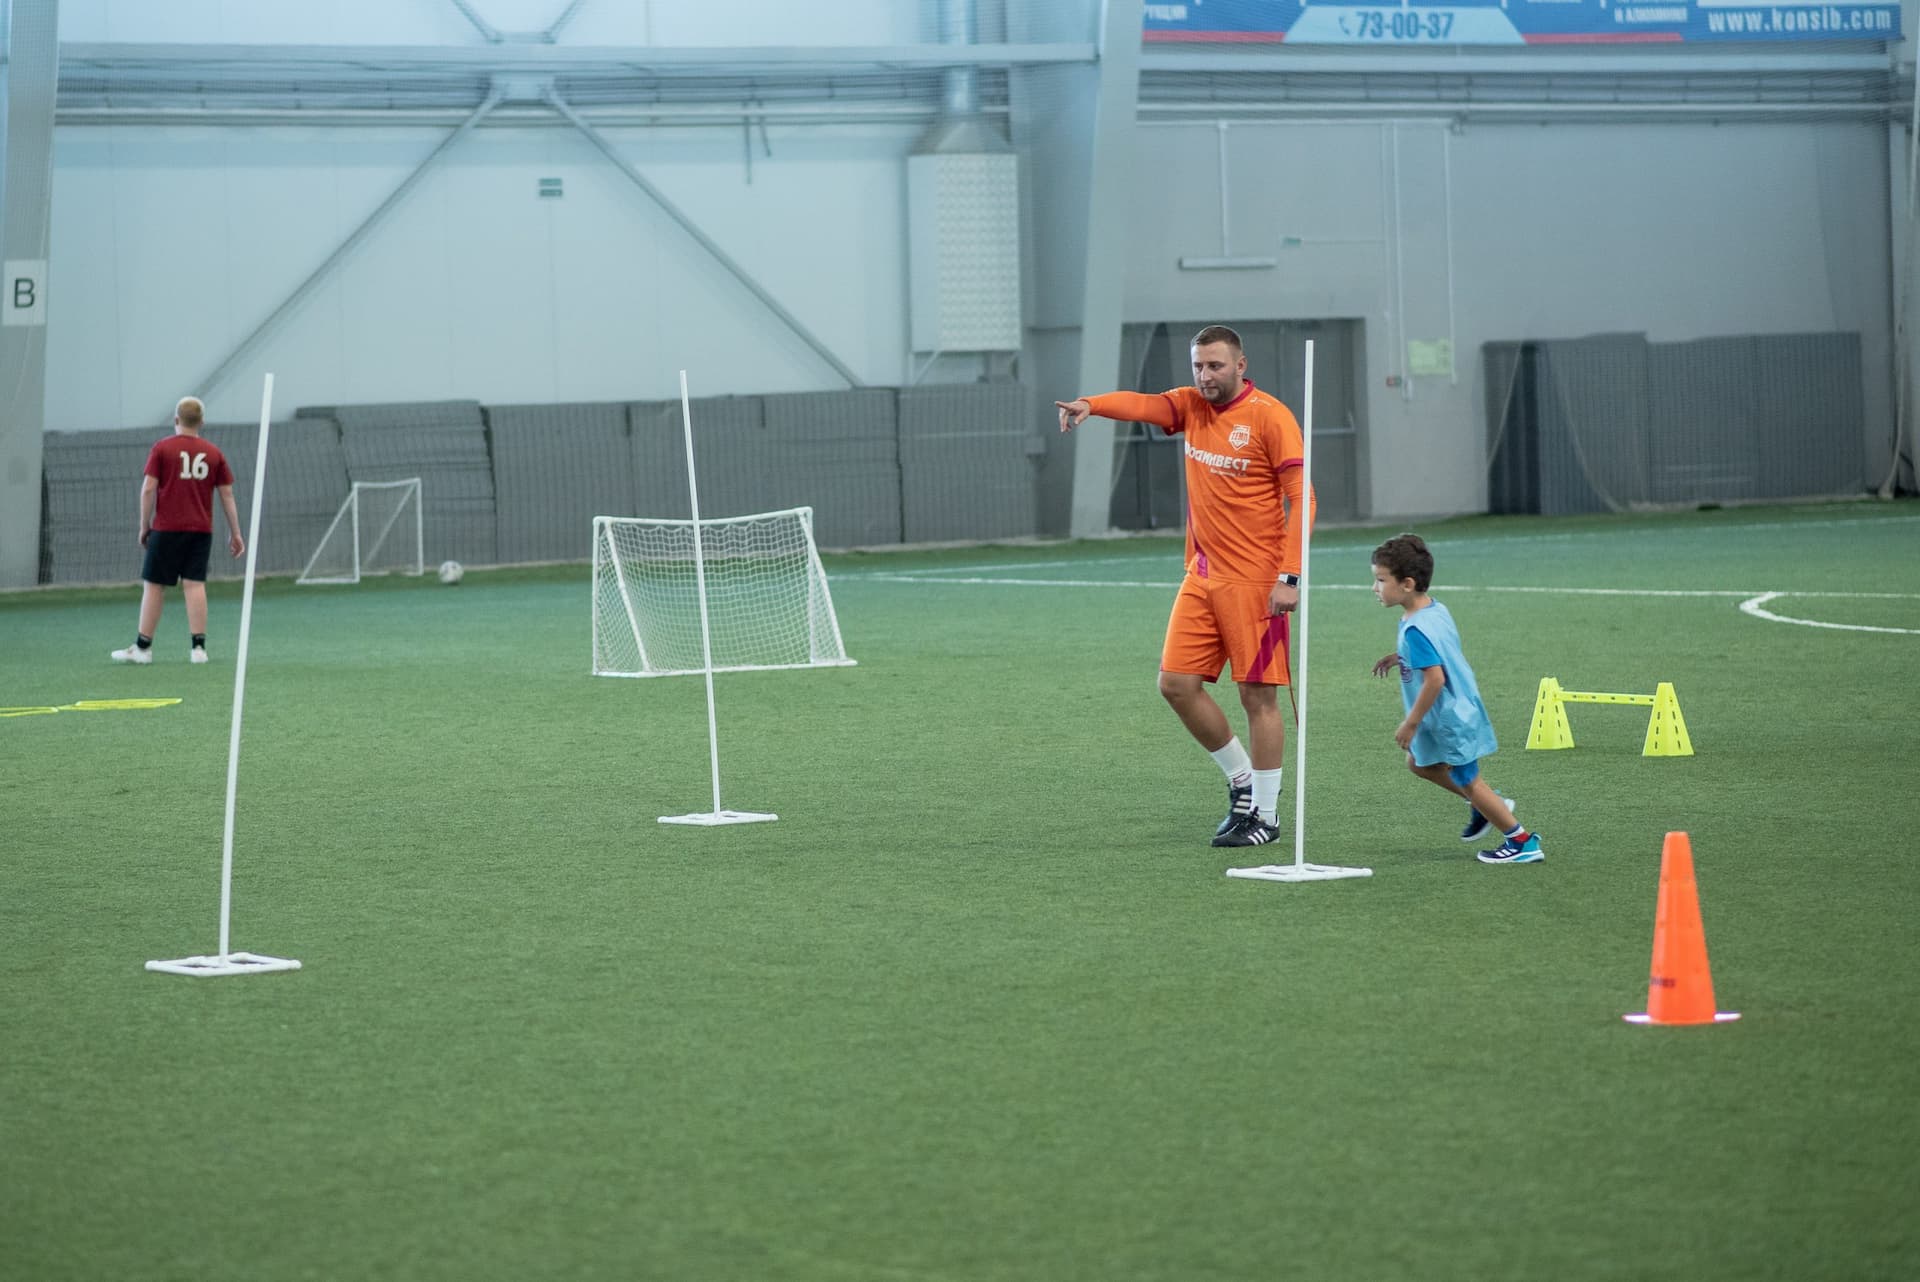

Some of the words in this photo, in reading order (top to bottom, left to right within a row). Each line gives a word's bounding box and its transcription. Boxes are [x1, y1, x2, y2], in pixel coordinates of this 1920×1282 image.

[1355, 11, 1454, 39] 73-00-37
[1708, 7, 1892, 33] www.konsib.com
[180, 451, 209, 479] 16
